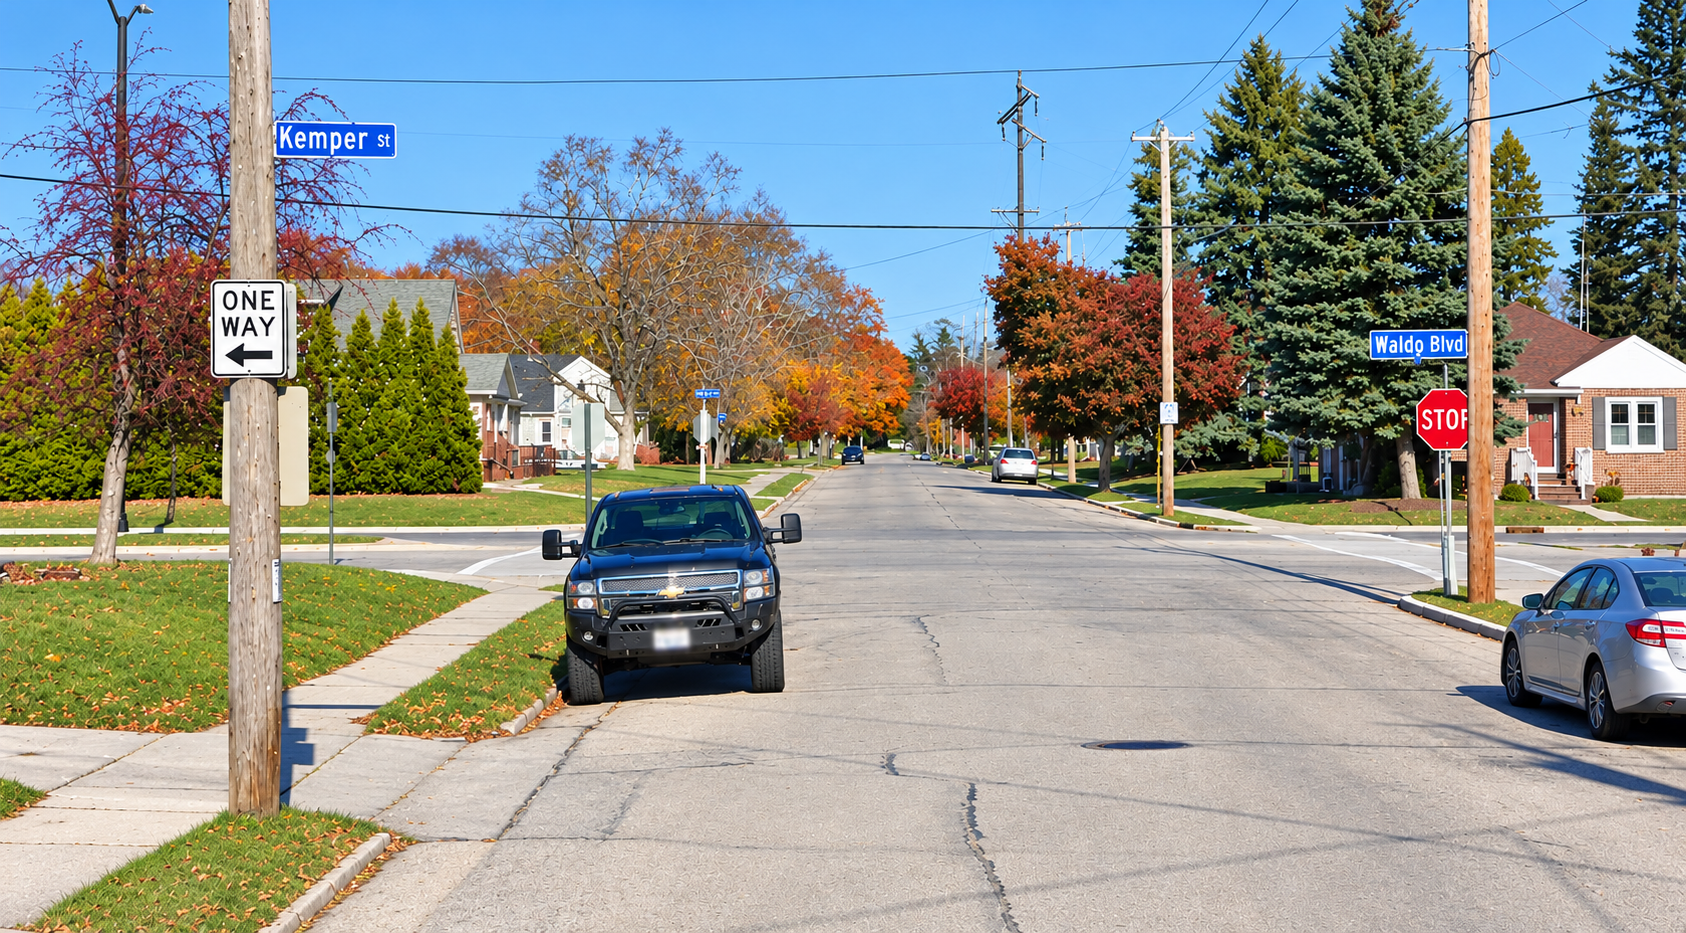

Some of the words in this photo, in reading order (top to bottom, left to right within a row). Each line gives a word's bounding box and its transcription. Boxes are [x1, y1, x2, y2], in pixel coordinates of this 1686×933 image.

[280, 125, 368, 155] Kemper
[222, 290, 275, 311] ONE
[221, 316, 276, 337] WAY
[1375, 335, 1424, 354] Waldo
[1430, 335, 1463, 352] Blvd
